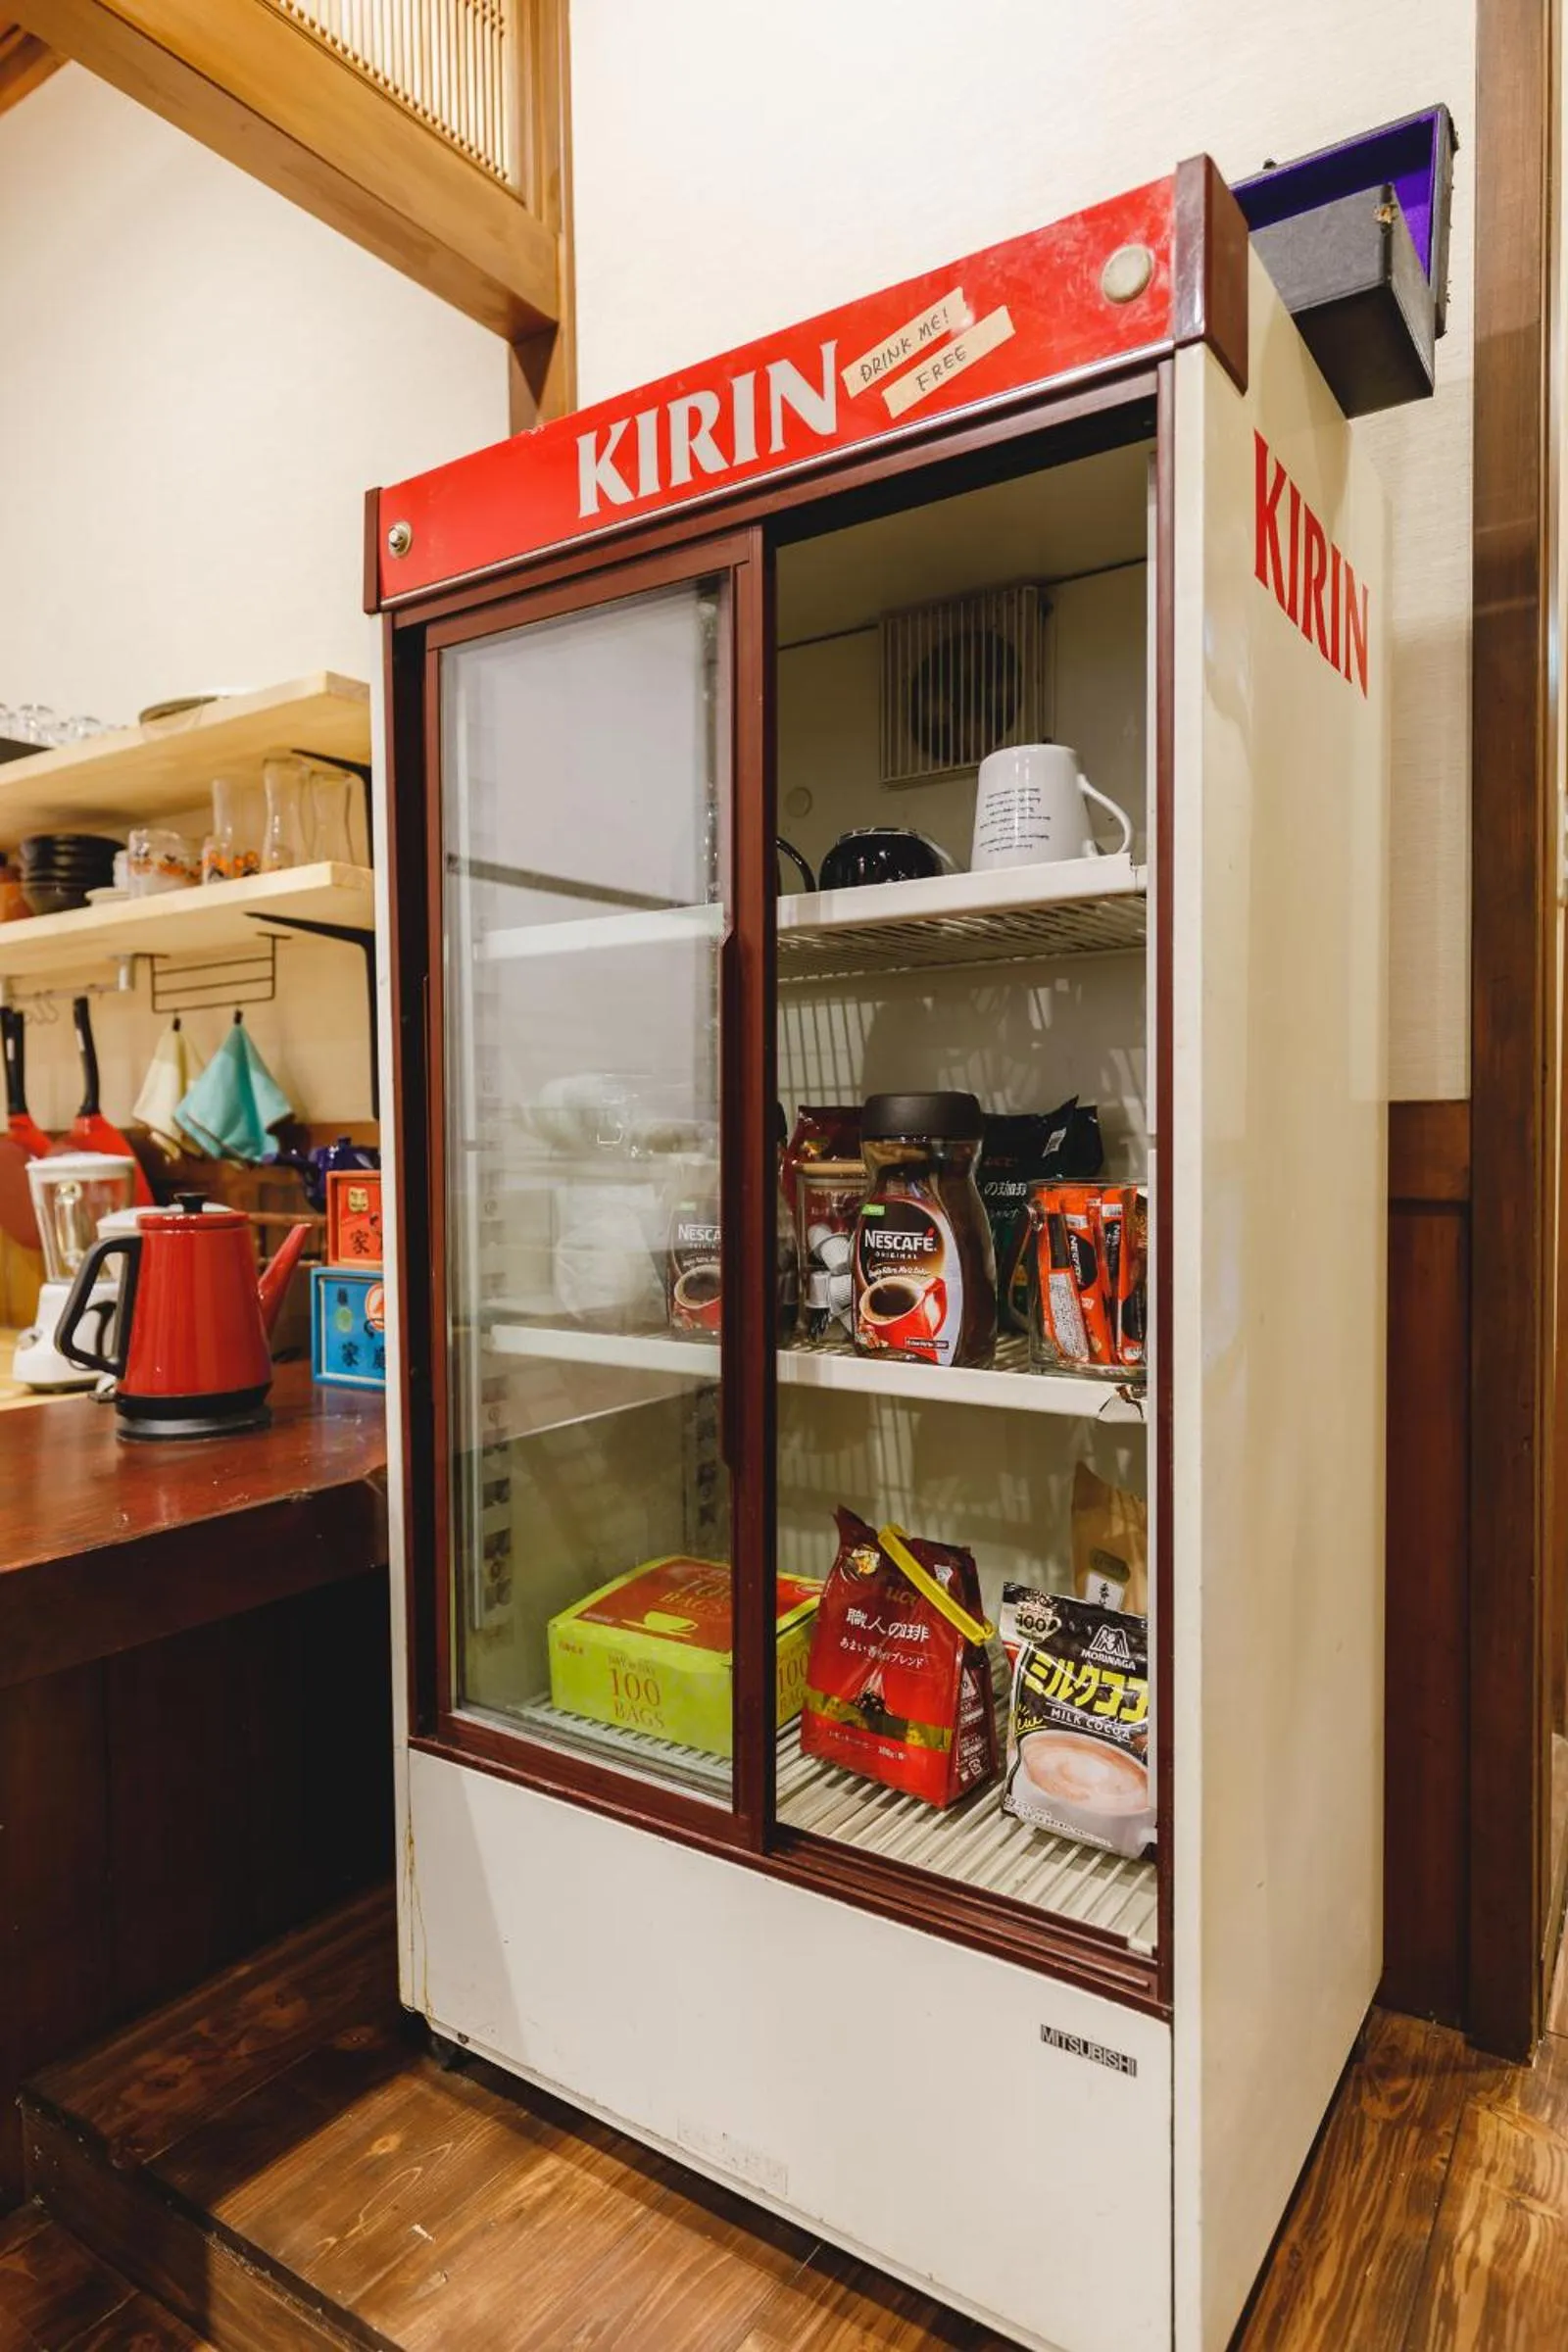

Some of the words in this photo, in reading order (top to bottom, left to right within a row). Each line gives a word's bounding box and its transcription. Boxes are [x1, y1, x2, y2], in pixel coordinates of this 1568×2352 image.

[859, 337, 912, 383] DRINK
[918, 306, 950, 342] ME!
[914, 344, 967, 392] FREE
[576, 339, 839, 518] KIRIN
[1253, 425, 1369, 701] KIRIN
[864, 1226, 937, 1252] NESCAFÉ
[609, 1668, 662, 1707] 100
[1052, 1707, 1082, 1726] MILK
[1040, 2023, 1138, 2079] MITSUBISHI
